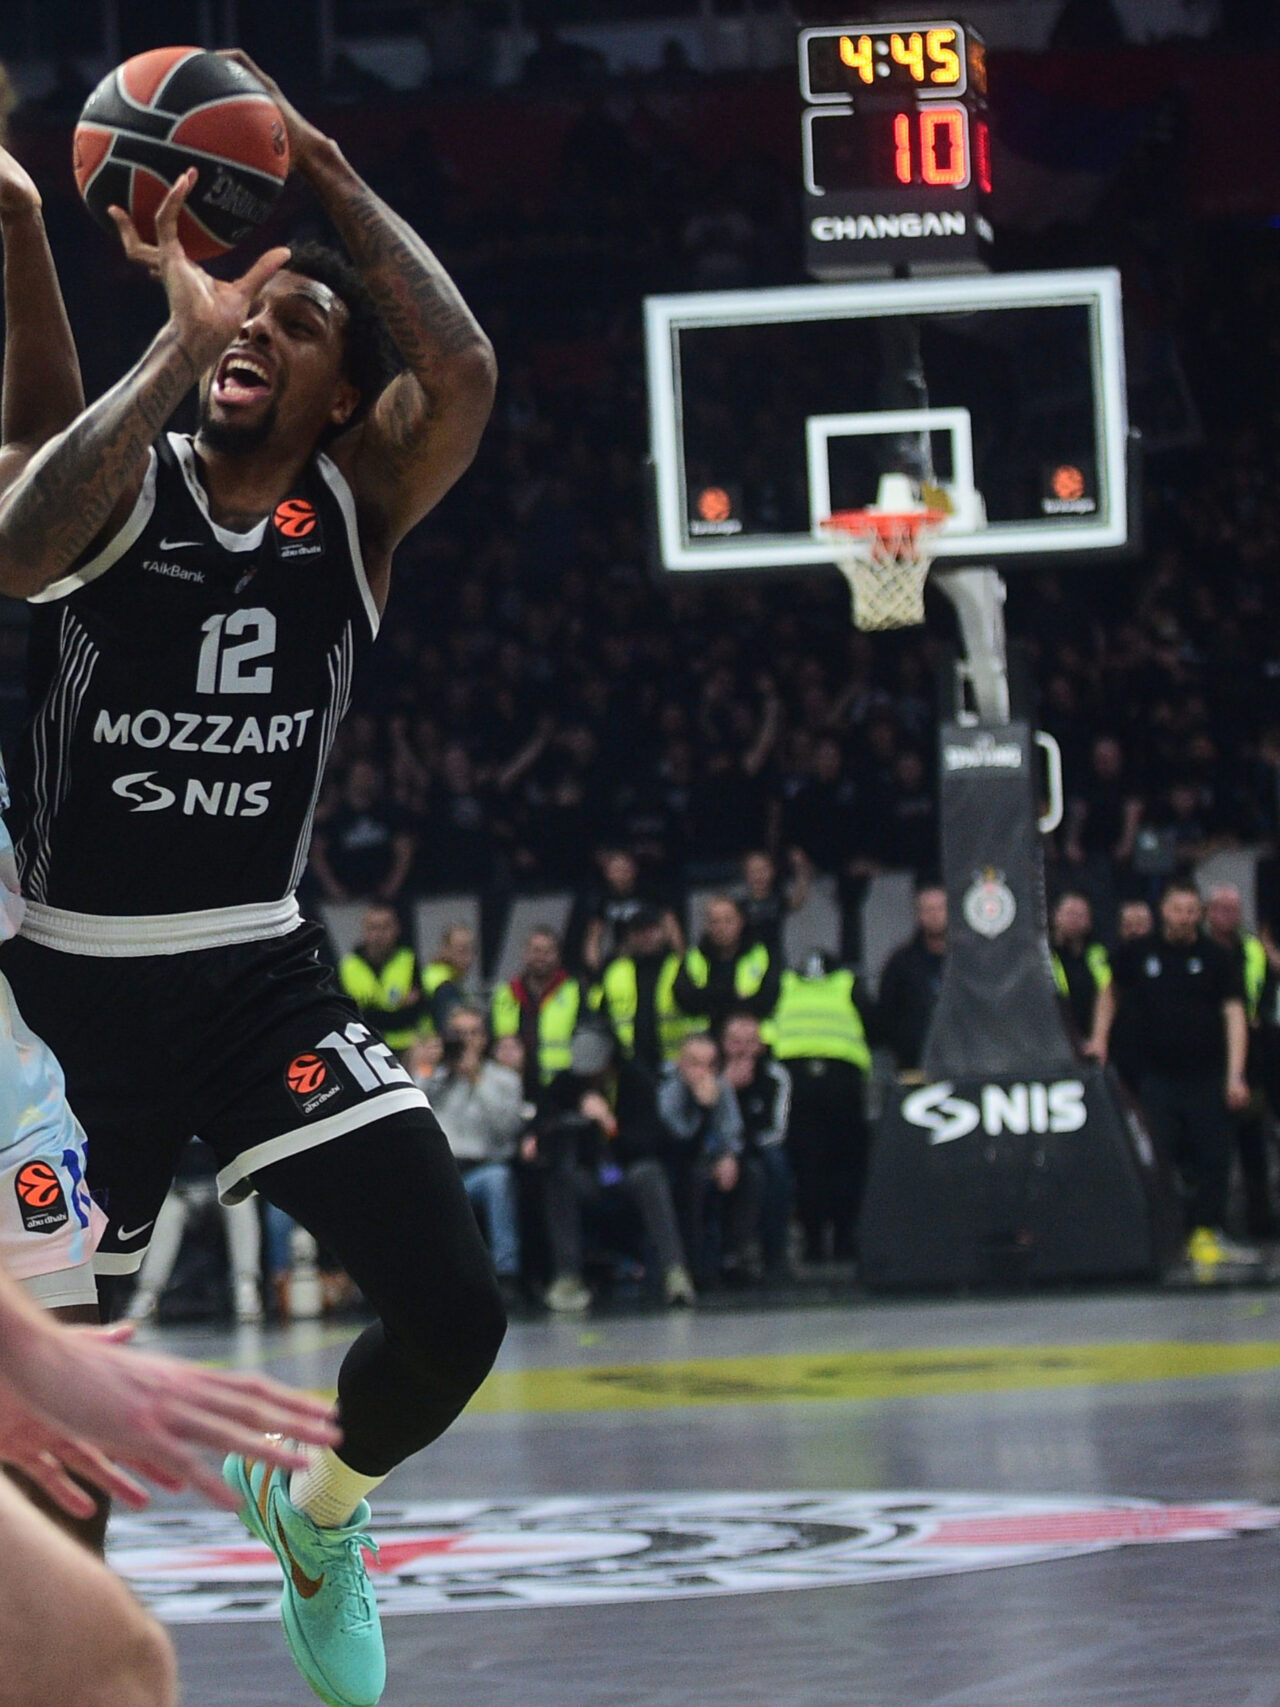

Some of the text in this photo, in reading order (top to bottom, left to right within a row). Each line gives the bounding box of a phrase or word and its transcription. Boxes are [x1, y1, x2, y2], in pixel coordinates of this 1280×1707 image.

[839, 28, 961, 84] 4:45
[893, 108, 968, 186] 10
[811, 210, 967, 242] CHANGAN
[195, 606, 277, 695] 12
[93, 708, 314, 754] MOZZART
[183, 778, 272, 817] NIS
[314, 1022, 417, 1093] 12
[981, 1079, 1088, 1136] NIS
